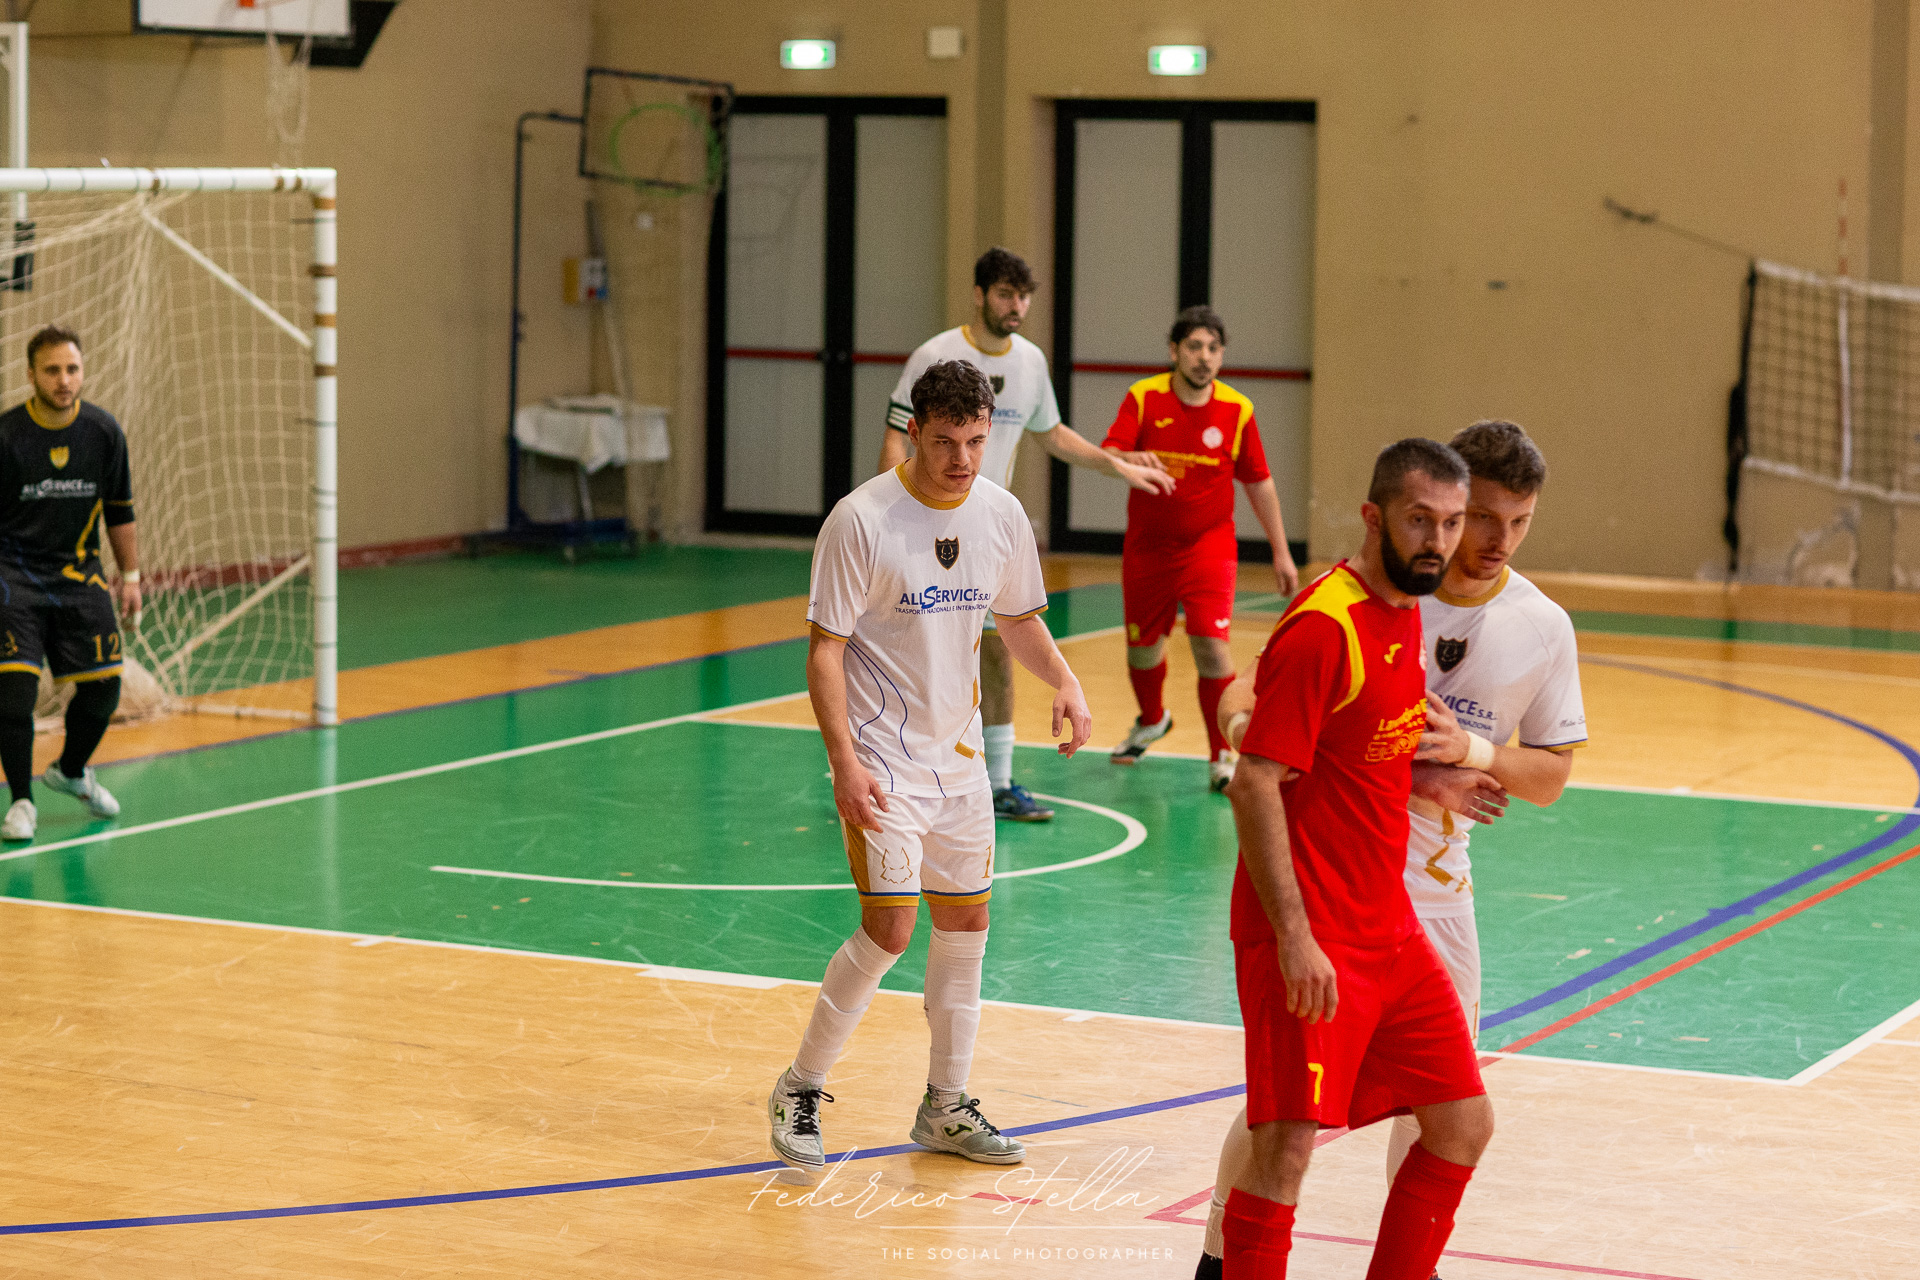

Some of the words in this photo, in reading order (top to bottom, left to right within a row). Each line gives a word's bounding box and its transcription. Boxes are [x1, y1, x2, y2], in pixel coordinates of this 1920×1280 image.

[895, 606, 926, 615] TRASPORTI
[899, 585, 979, 609] ALLSERVICE
[92, 632, 121, 662] 12
[1308, 1062, 1324, 1105] 7
